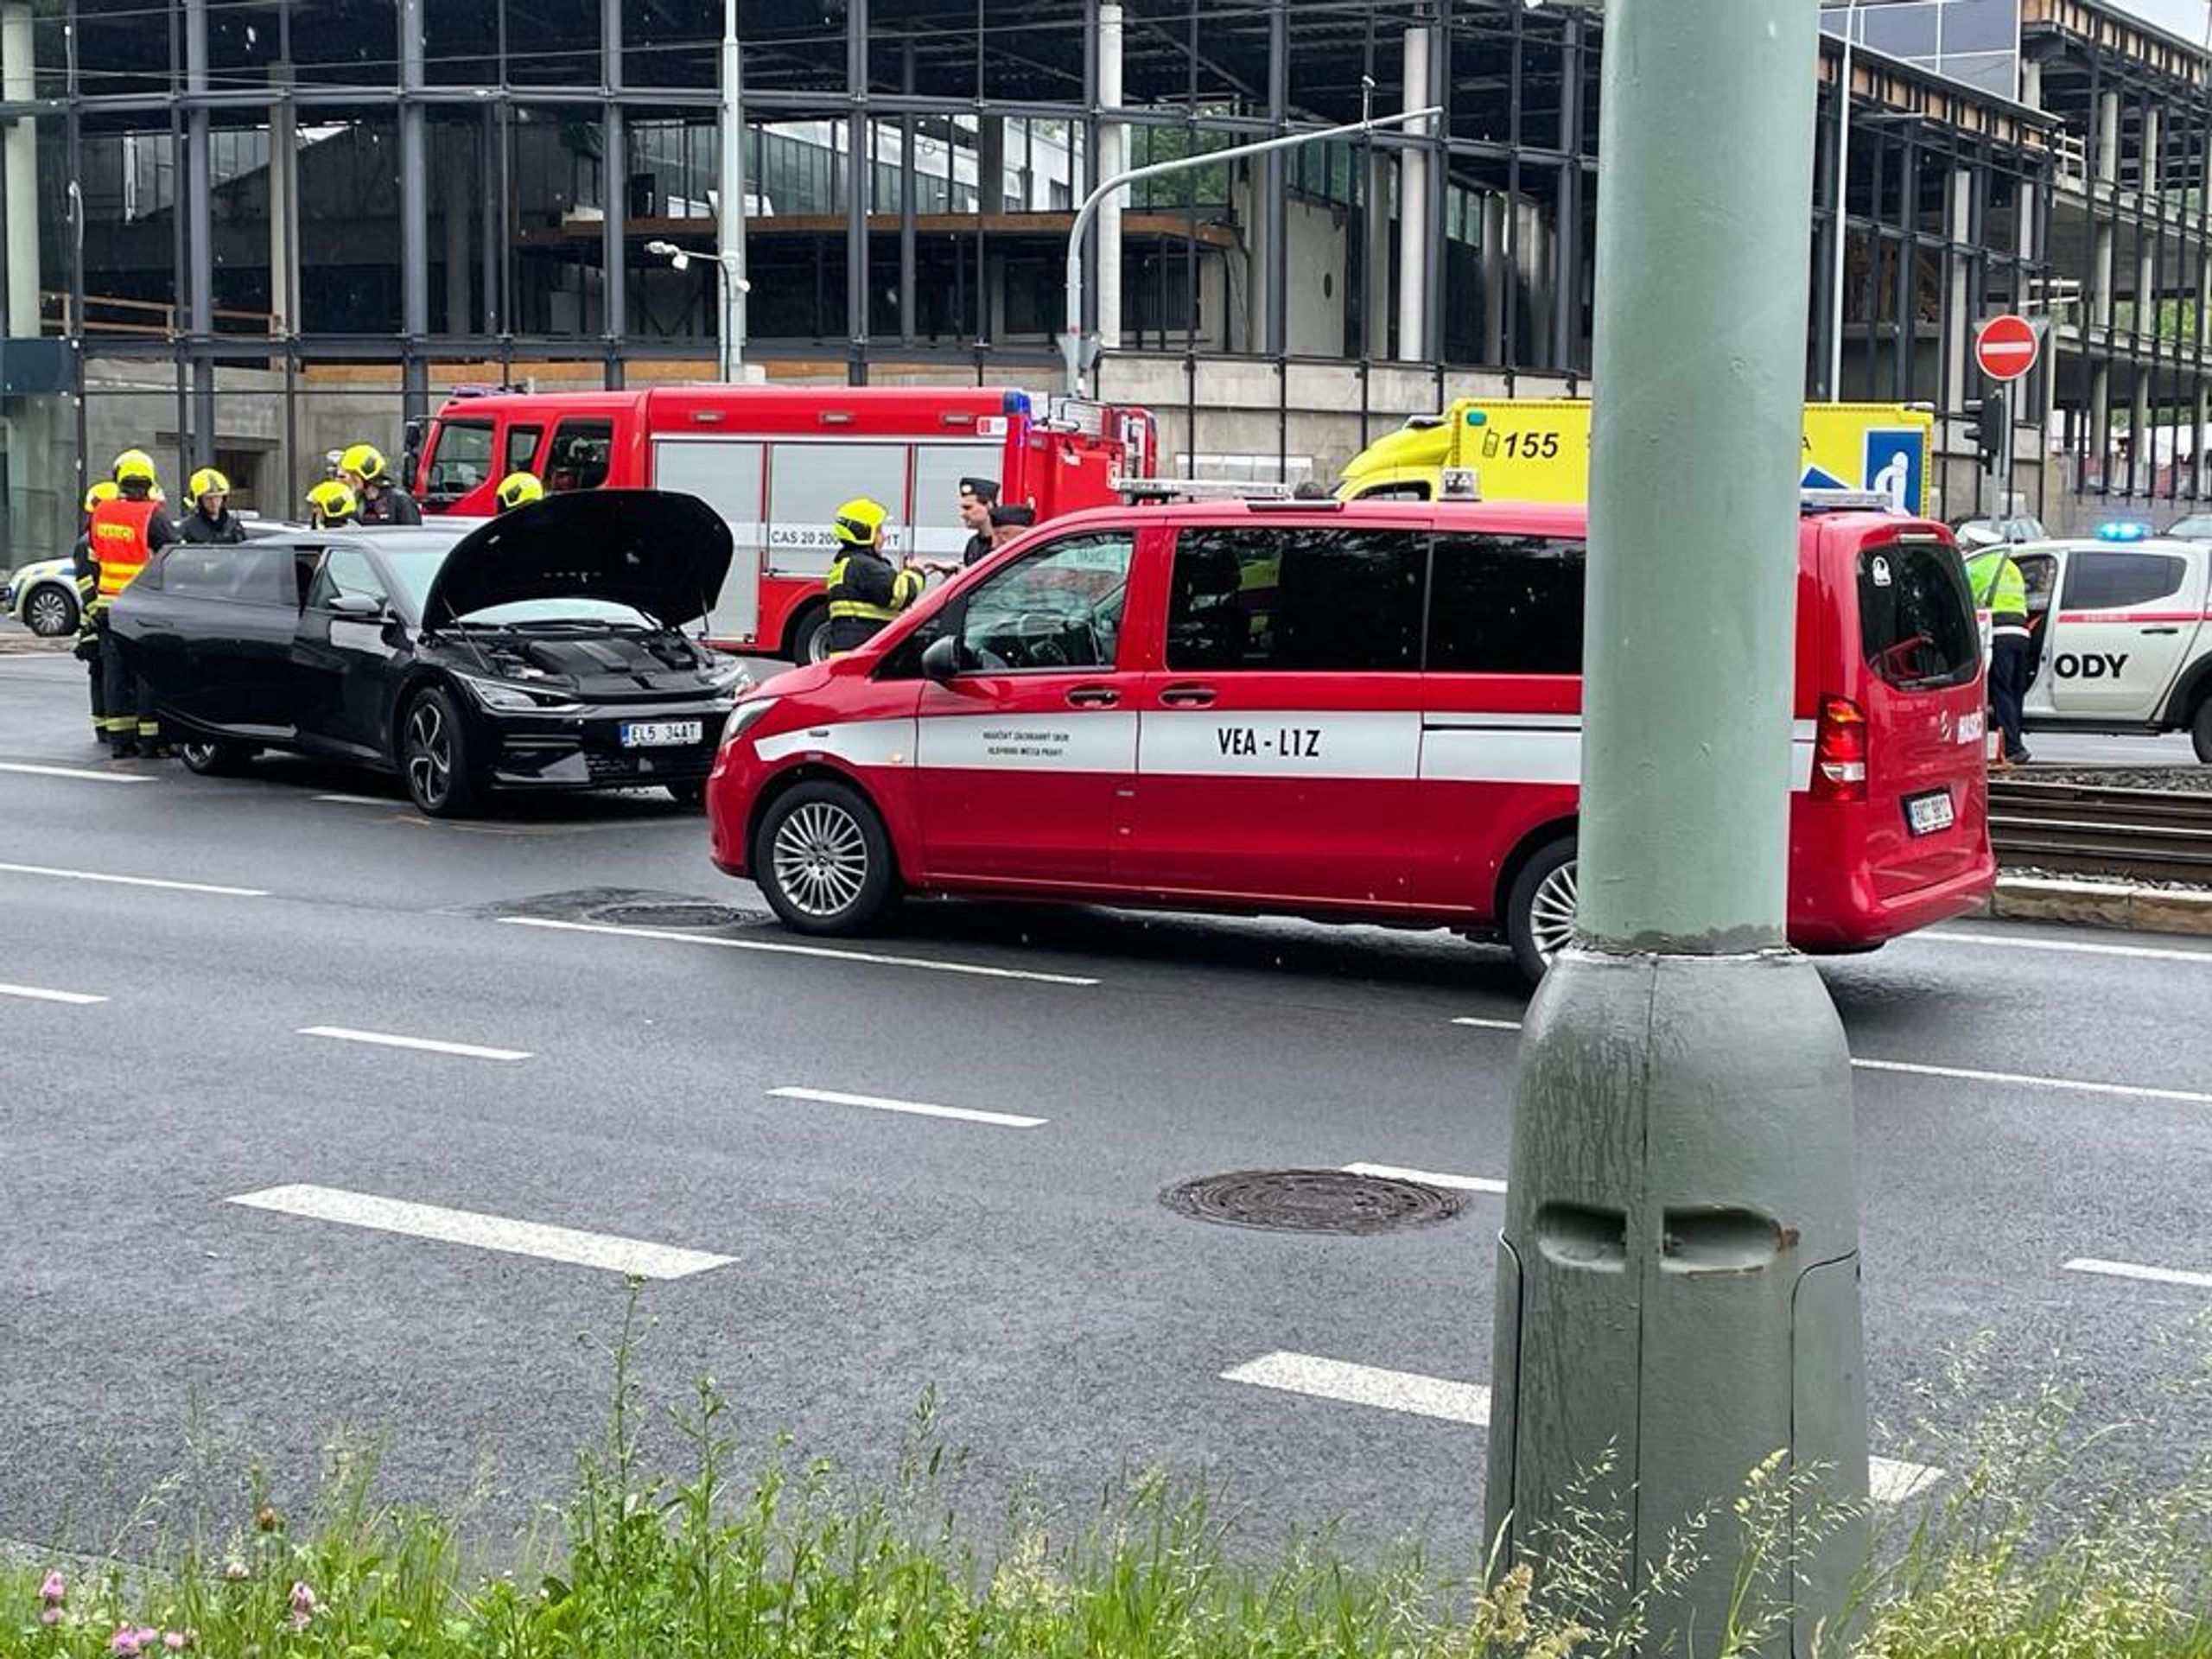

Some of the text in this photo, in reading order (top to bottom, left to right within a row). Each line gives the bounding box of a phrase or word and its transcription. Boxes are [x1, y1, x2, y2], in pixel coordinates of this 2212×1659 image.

[1504, 432, 1559, 459] 155
[771, 531, 798, 543] CAS
[801, 531, 816, 545] 20
[2054, 653, 2128, 678] ODY
[1217, 728, 1256, 755] VEA
